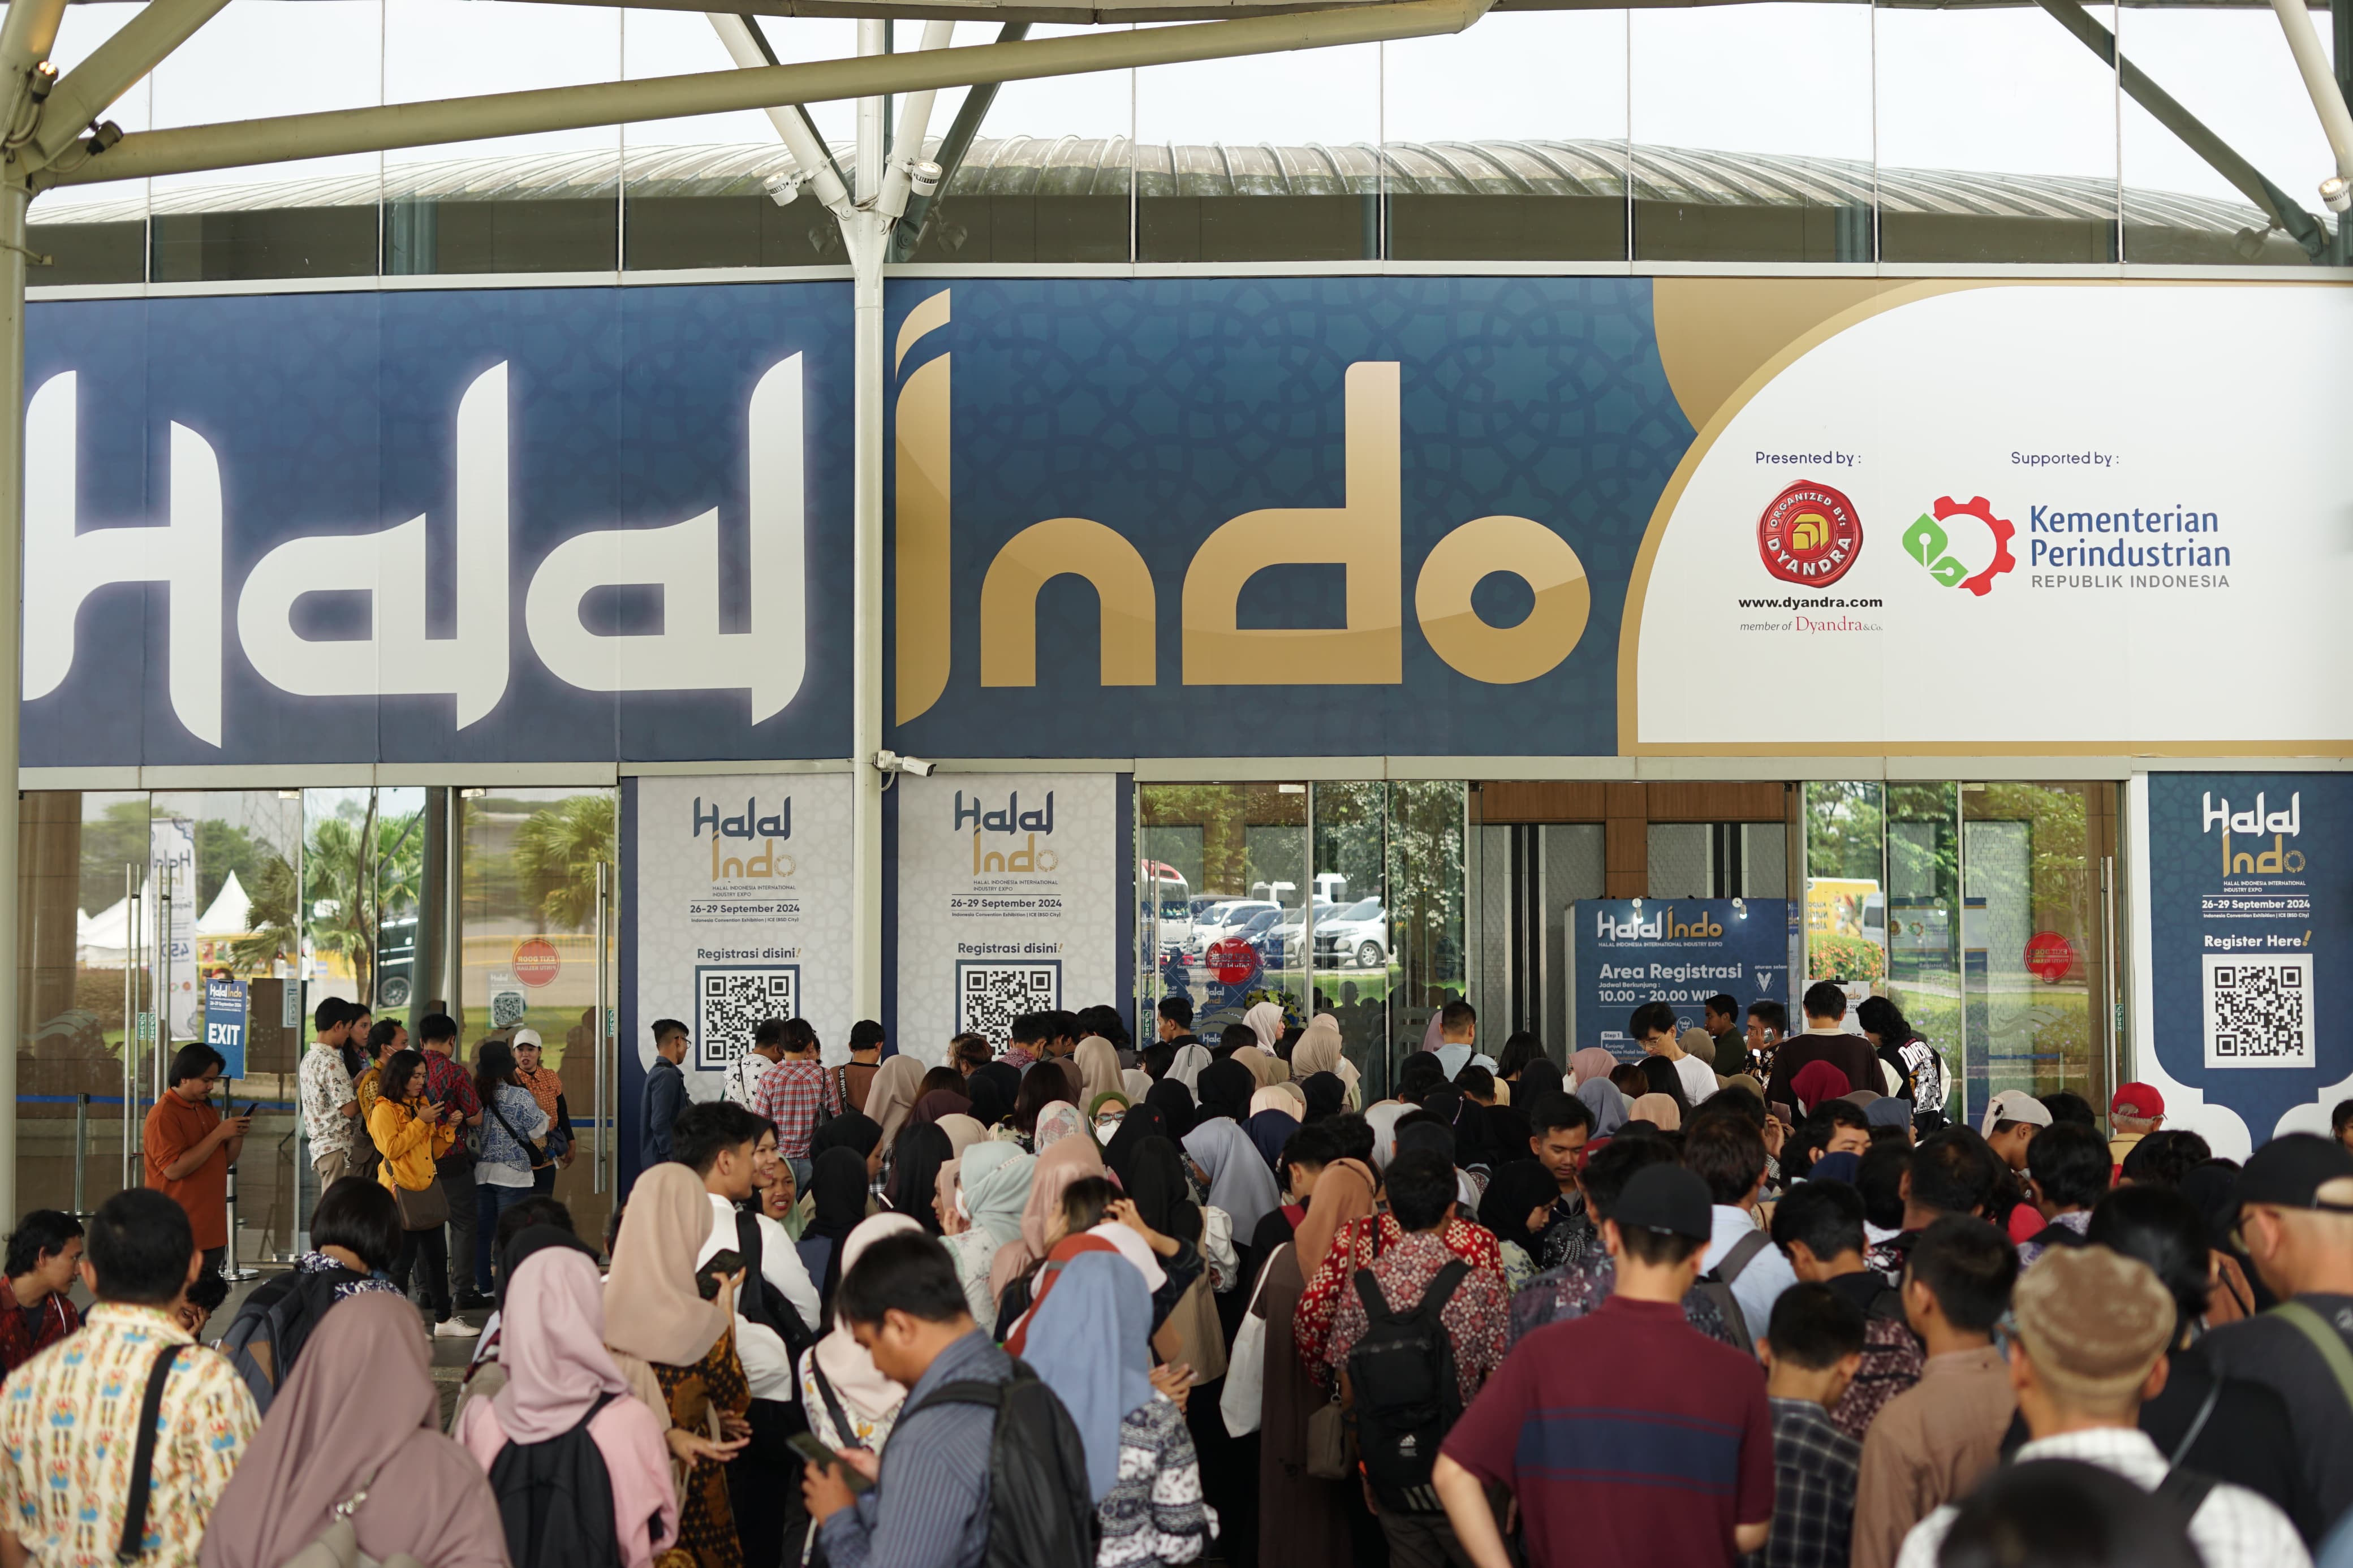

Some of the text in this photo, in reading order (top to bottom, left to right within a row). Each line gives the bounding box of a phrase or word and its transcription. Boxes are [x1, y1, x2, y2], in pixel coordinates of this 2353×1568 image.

[1756, 451, 1832, 464] Presented
[1836, 451, 1854, 466] by
[2011, 451, 2091, 467] Supported
[2095, 451, 2112, 467] by
[1770, 493, 1847, 528] ORGANIZED BY:
[2031, 504, 2218, 532] Kementerian
[23, 350, 806, 749] Halal
[1767, 538, 1852, 576] DYANDRA
[2031, 538, 2230, 567] Perindustrian
[2032, 574, 2230, 588] REPUBLIK INDONESIA
[1739, 597, 1882, 610] www.dyandra.com
[1740, 621, 1780, 631] member
[1782, 621, 1792, 631] of
[693, 796, 791, 841] Halal
[955, 790, 1054, 836] Halal
[2203, 791, 2300, 837] Halal
[721, 905, 774, 914] September
[776, 904, 800, 913] 2024
[982, 899, 1036, 909] September
[2232, 900, 2285, 910] September
[2287, 900, 2311, 908] 2024
[1597, 910, 1662, 941] Halal
[2205, 930, 2312, 950] Register Here!
[697, 948, 801, 961] Registrasi disini!
[958, 943, 1063, 956] Registrasi disini!
[1599, 962, 1742, 983] Area Registrasi
[210, 983, 227, 997] Halal
[1598, 990, 1635, 1001] 10.00
[1649, 990, 1688, 1001] 20.00
[208, 1023, 240, 1045] EXIT
